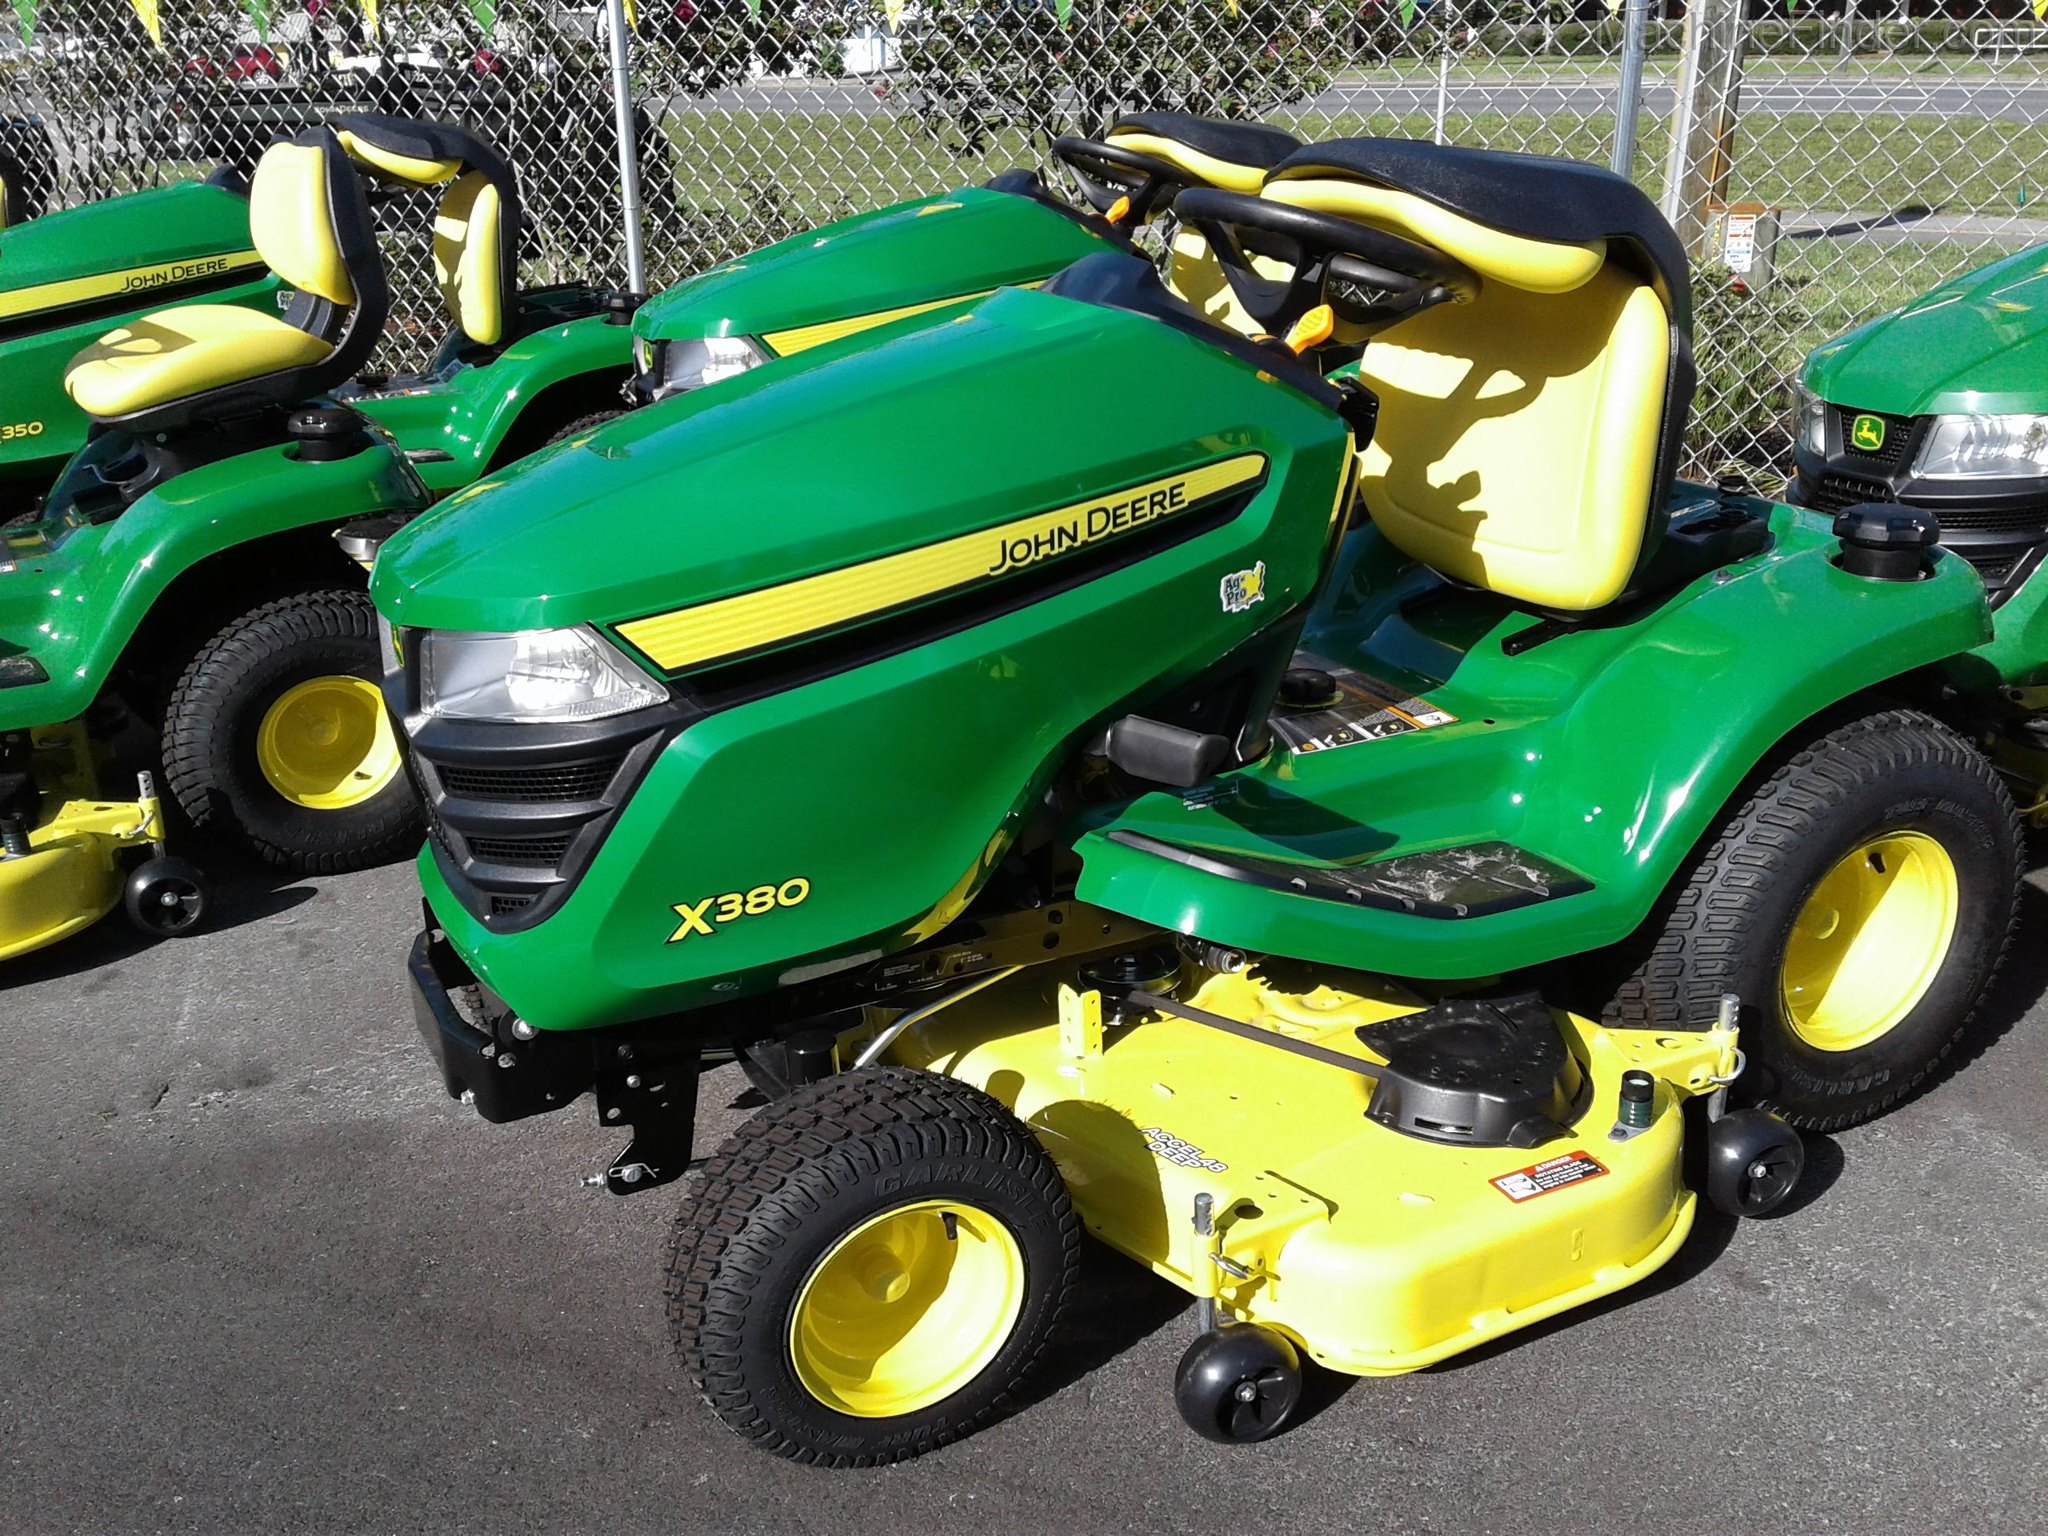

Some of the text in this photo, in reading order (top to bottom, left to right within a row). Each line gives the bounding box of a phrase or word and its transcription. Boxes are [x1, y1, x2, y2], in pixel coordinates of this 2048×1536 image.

[121, 258, 229, 292] JOHN DEERE
[0, 420, 44, 443] 350
[989, 480, 1187, 573] JOHN DEERE
[665, 876, 811, 944] X380
[1144, 1140, 1203, 1168] DEEP
